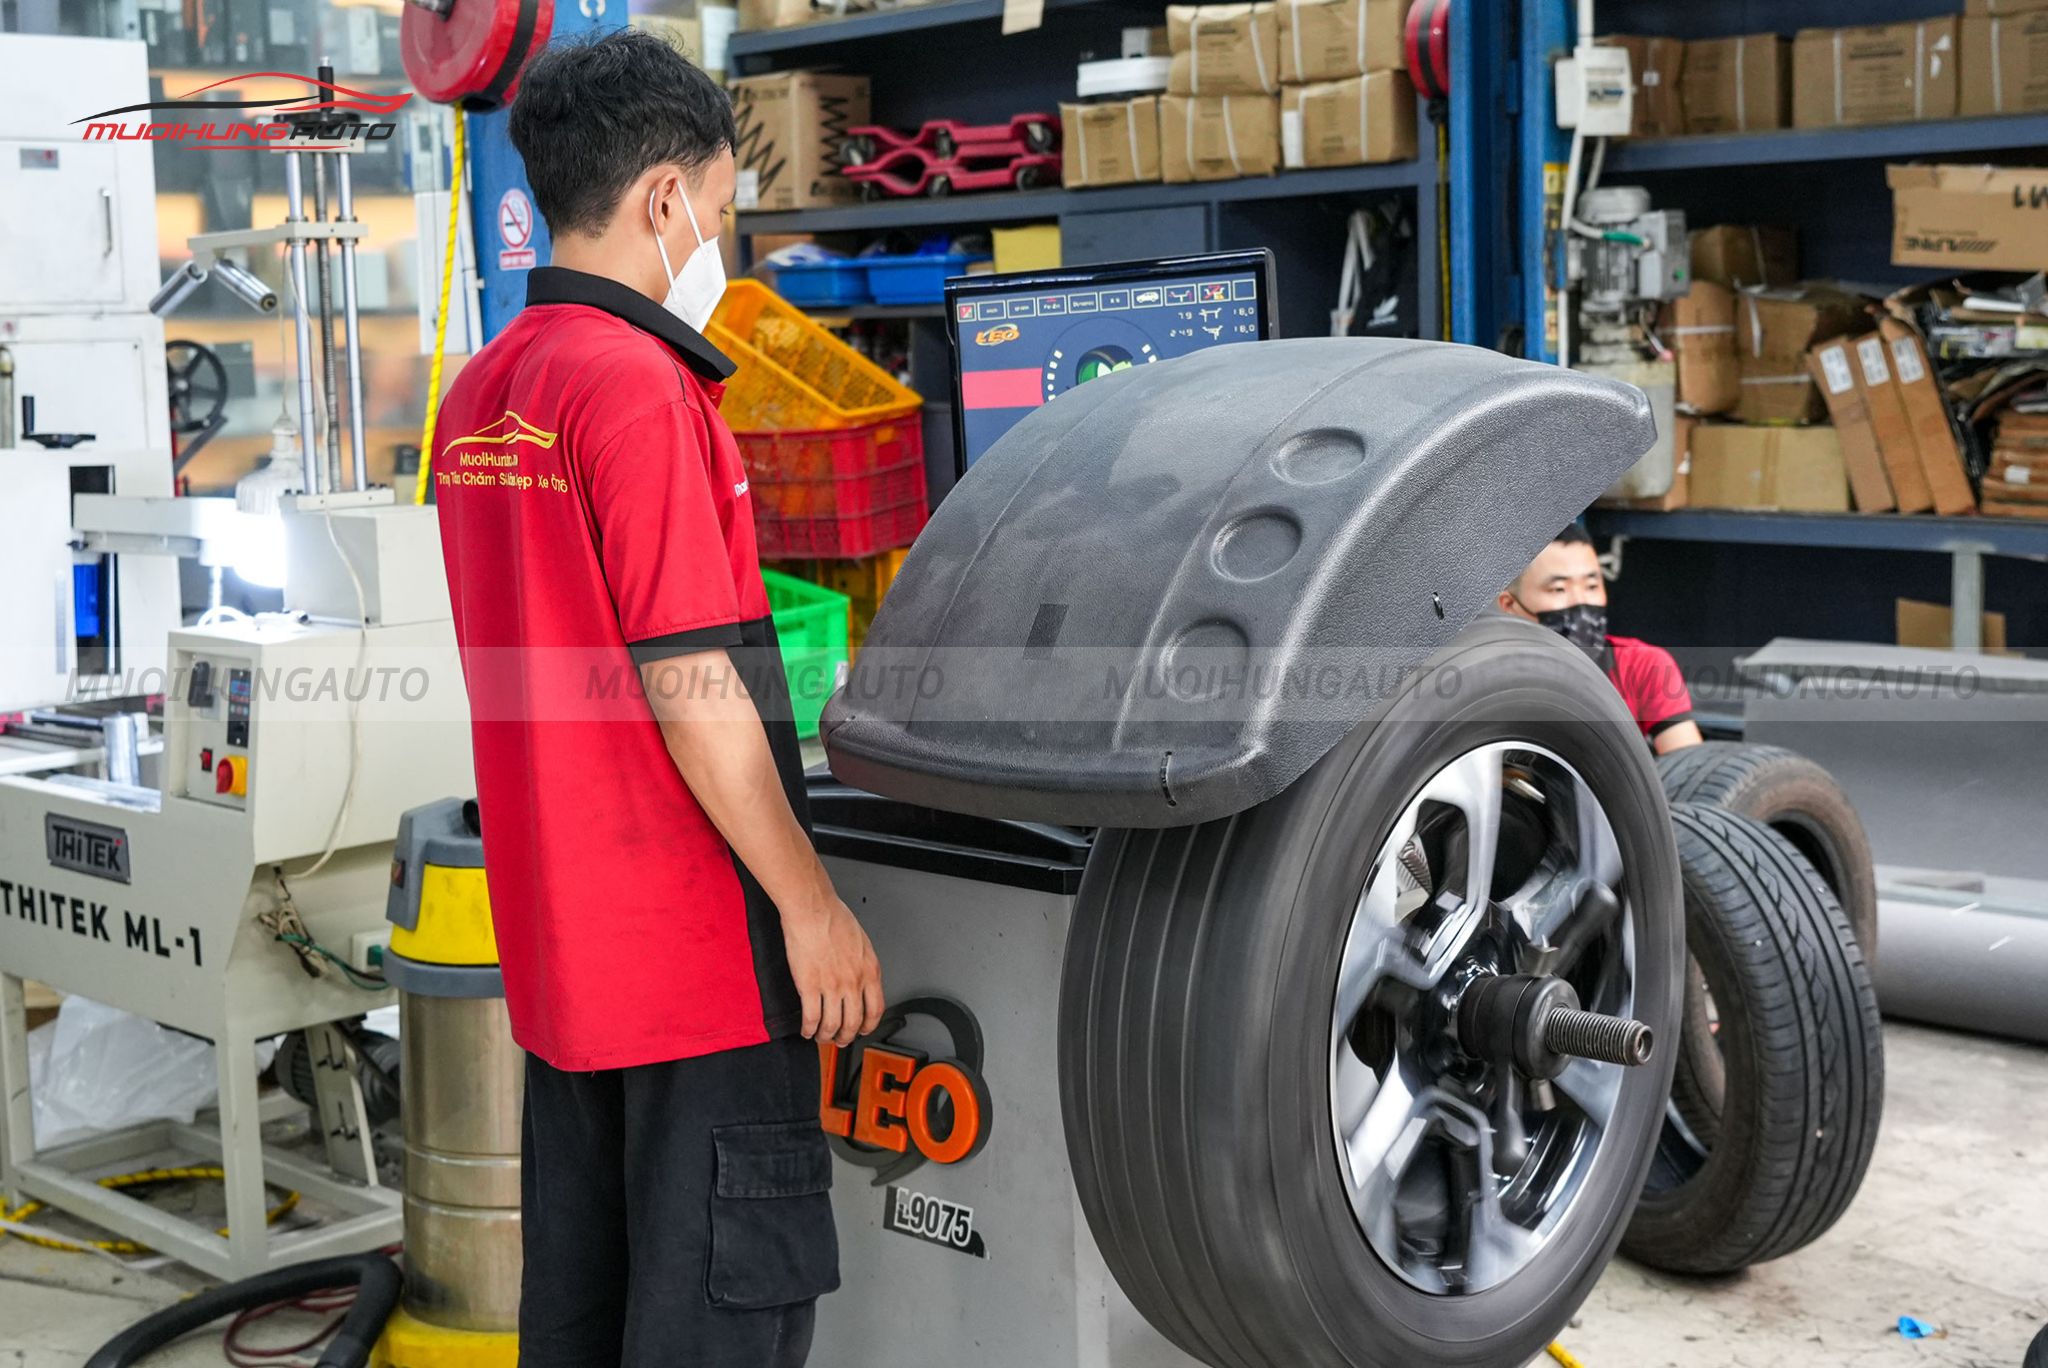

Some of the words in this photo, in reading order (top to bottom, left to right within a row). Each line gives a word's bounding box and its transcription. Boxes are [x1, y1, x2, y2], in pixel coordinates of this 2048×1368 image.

[975, 328, 1020, 344] LEO
[462, 471, 496, 486] Chăm
[537, 474, 549, 489] Xe
[0, 879, 110, 943] THITEK
[124, 910, 202, 968] ML-1
[819, 1041, 980, 1164] LEO
